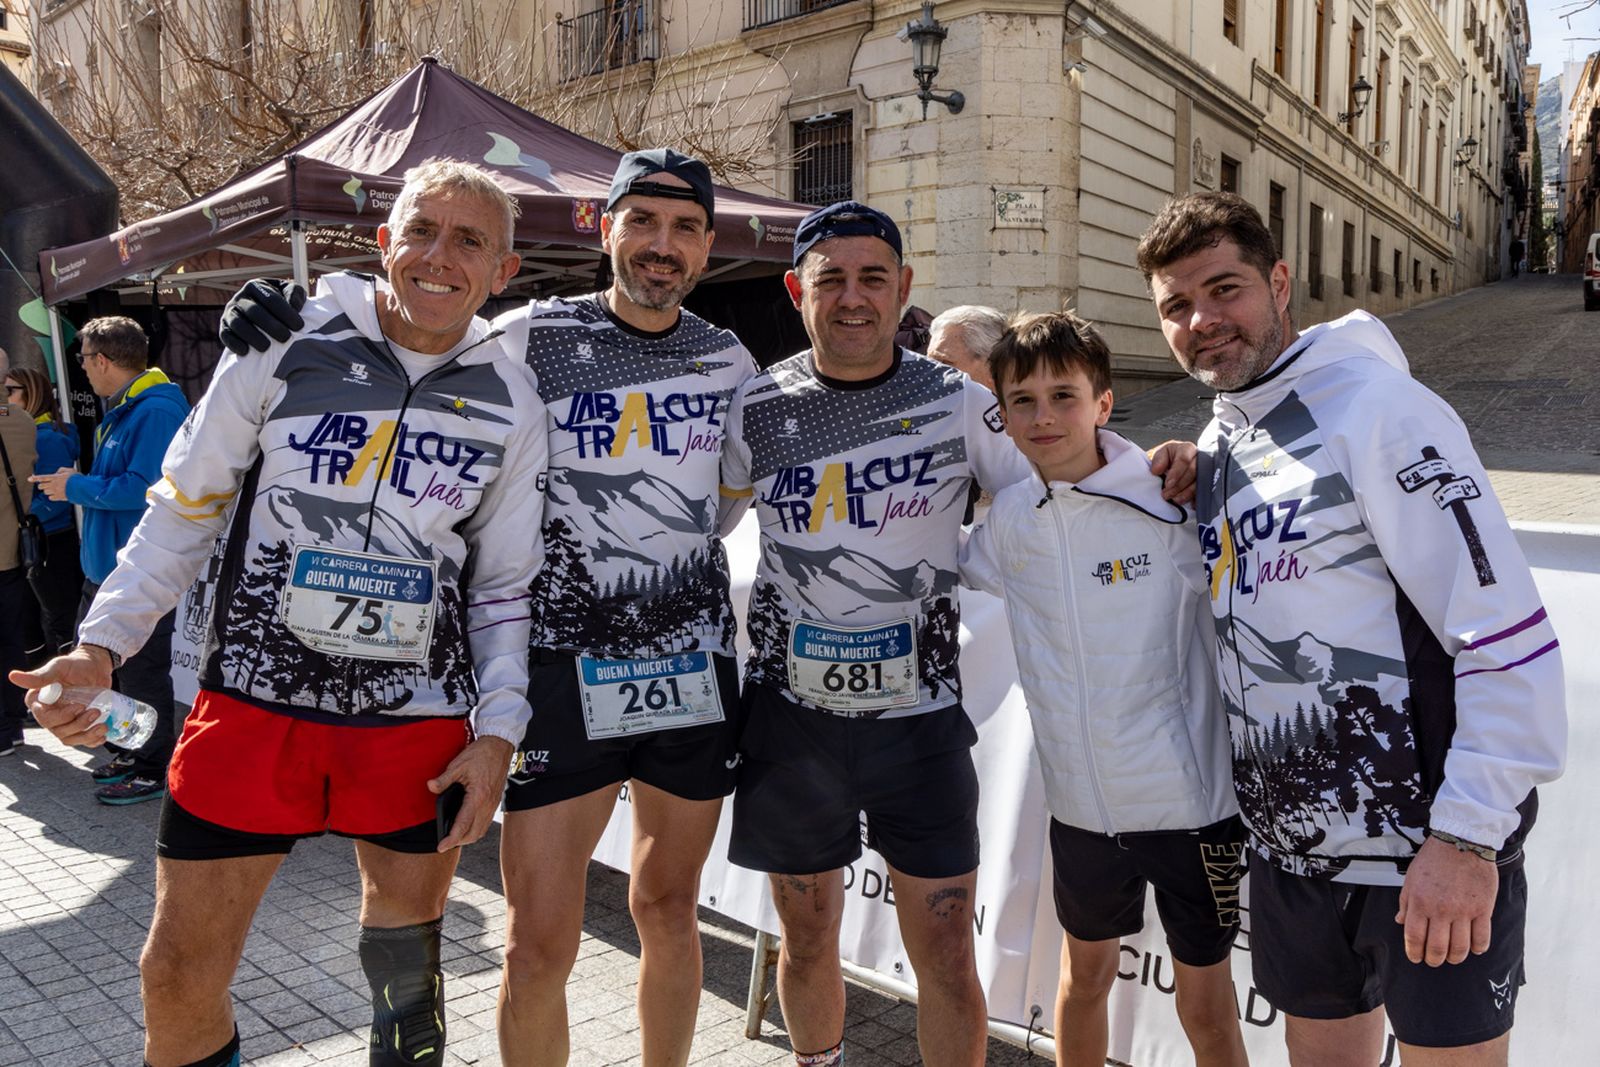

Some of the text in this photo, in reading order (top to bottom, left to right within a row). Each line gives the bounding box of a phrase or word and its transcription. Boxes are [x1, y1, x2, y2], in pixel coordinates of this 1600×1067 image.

[555, 391, 721, 431] JABALCUZ
[289, 412, 486, 484] JABALCUZ
[569, 422, 680, 459] TRAIL
[305, 430, 465, 511] TRAIL Jaén
[761, 451, 938, 506] JABALCUZ
[771, 491, 934, 537] TRAIL Jaén
[305, 570, 397, 596] BUENA MUERTE
[321, 556, 368, 572] CARRERA
[371, 564, 423, 580] CAMINATA
[1091, 553, 1152, 578] JABALCUZ
[1100, 566, 1134, 586] TRAIL
[1252, 549, 1309, 605] Jaén
[290, 624, 306, 632] JUAN
[306, 628, 332, 638] AGUSTIN
[329, 594, 384, 636] 75
[805, 642, 881, 659] BUENA MUERTE
[815, 630, 854, 643] CARRERA
[856, 628, 899, 643] CAMINATA
[596, 659, 675, 681] BUENA MUERTE
[823, 662, 882, 693] 681
[618, 677, 682, 714] 261
[1200, 842, 1241, 927] NIKE
